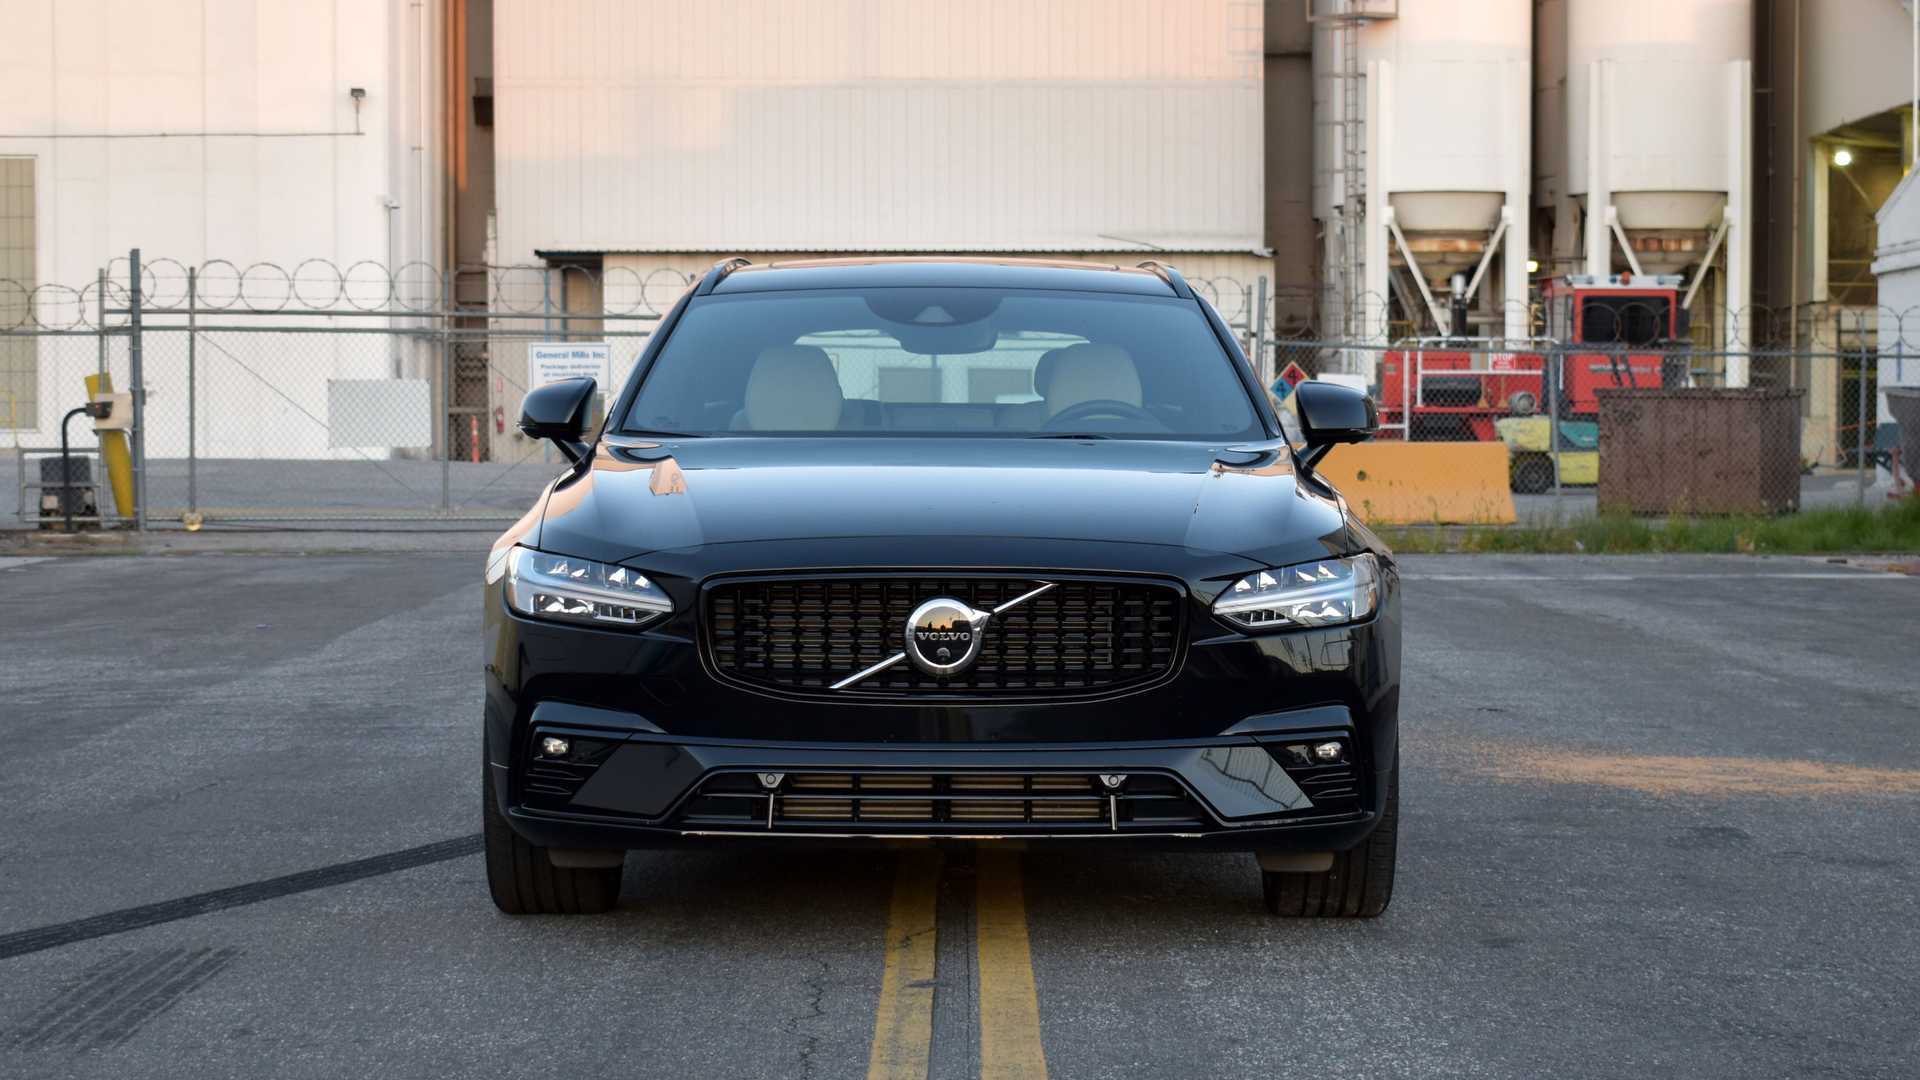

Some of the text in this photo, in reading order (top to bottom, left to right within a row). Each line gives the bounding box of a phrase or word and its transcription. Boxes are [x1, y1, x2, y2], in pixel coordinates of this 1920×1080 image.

[536, 351, 606, 359] General Mills Inc
[1492, 352, 1515, 361] STOP
[1287, 368, 1297, 384] 4
[916, 631, 970, 641] VOLVO
